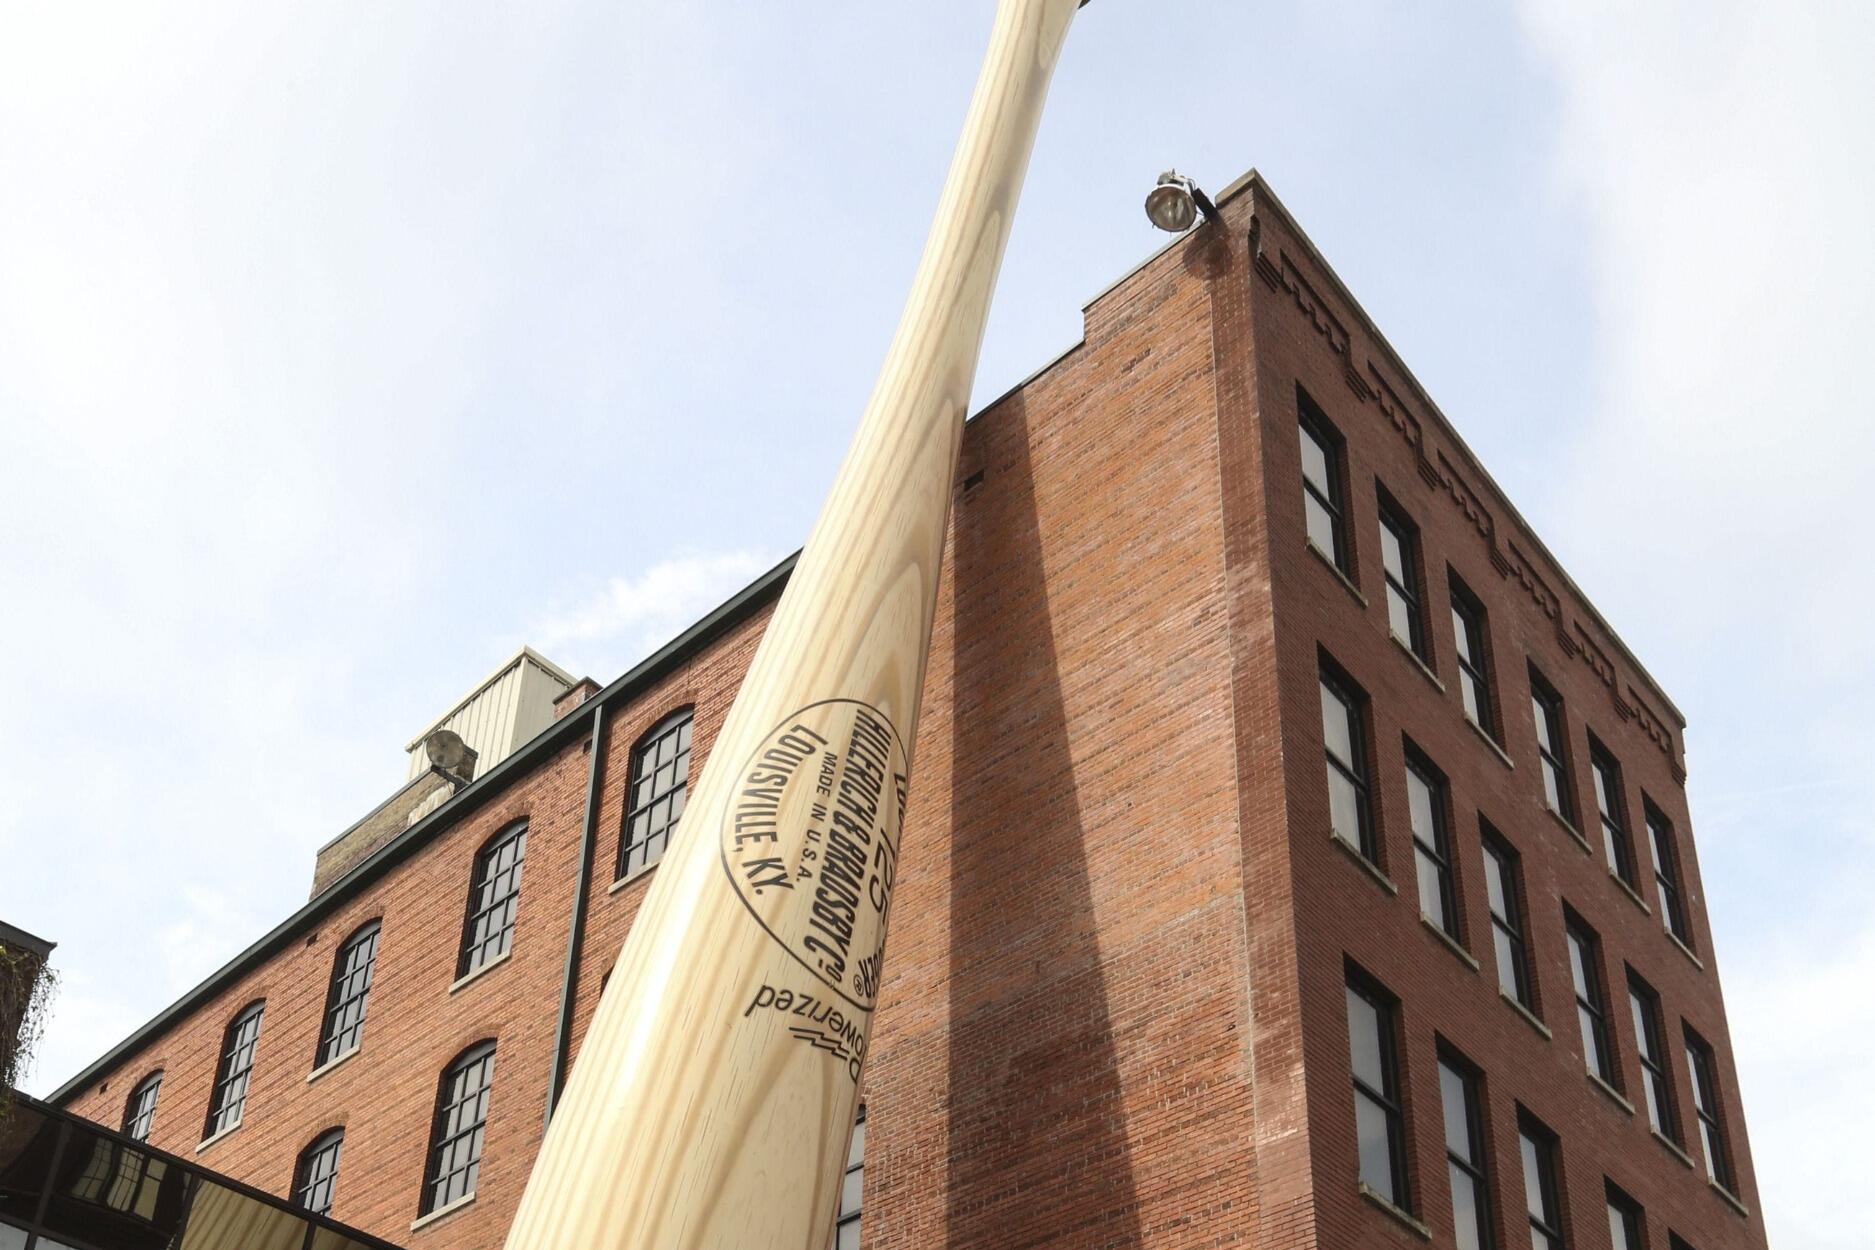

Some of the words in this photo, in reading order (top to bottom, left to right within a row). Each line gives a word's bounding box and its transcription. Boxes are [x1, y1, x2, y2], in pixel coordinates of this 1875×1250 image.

[733, 724, 829, 852] LOUISVILLE,
[816, 751, 839, 798] MADE
[837, 708, 891, 829] HILLERICH
[811, 803, 827, 822] IN
[833, 810, 870, 845] &
[742, 857, 795, 895] KY.
[796, 828, 821, 882] U.S.A.
[809, 828, 868, 957] BRADSBY
[869, 827, 896, 925] 125
[745, 985, 866, 1085] Powerized
